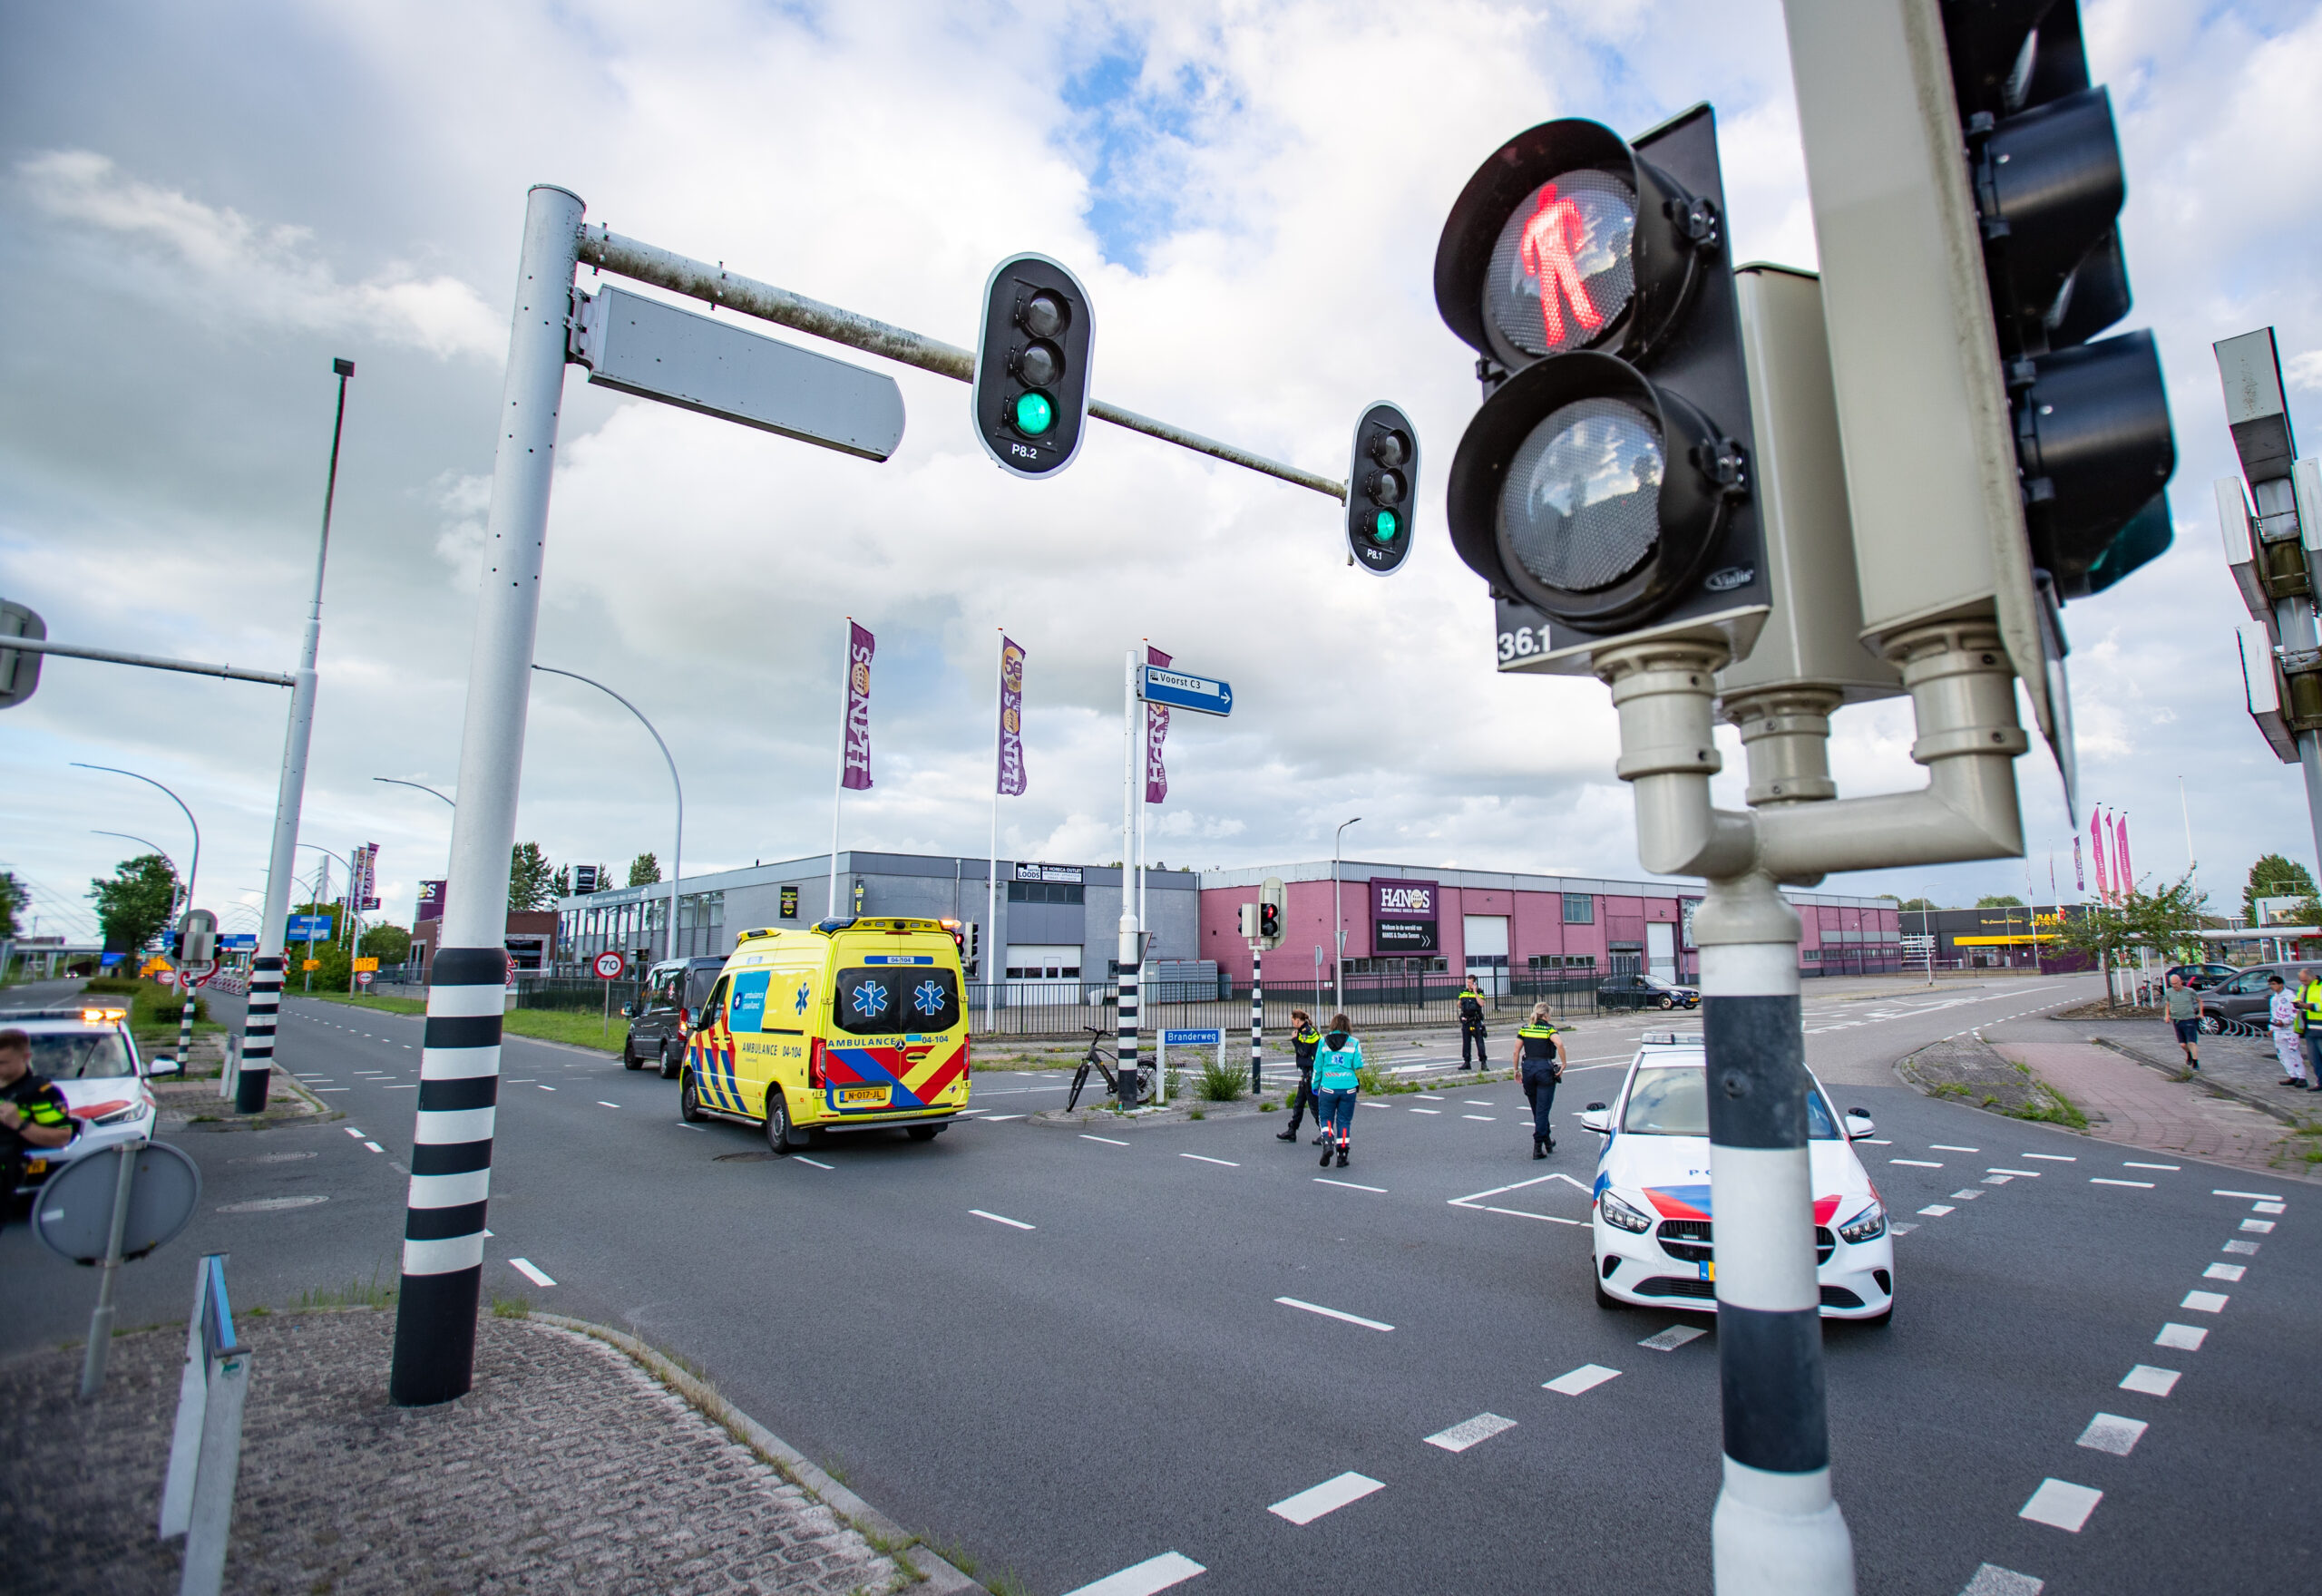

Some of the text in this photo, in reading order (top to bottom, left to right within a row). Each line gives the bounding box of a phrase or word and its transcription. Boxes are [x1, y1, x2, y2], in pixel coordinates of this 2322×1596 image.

[1011, 443, 1038, 460] P8.2
[1367, 548, 1382, 560] P8.1
[1498, 624, 1551, 661] 36.1
[1160, 673, 1202, 689] Voorst C3
[845, 643, 871, 773] HANOS
[1001, 692, 1020, 793] HANOS
[1381, 888, 1430, 909] HANOS
[600, 960, 618, 970] 70
[828, 1037, 895, 1047] AMBULANCE
[922, 1036, 949, 1044] 04-104
[1167, 1032, 1216, 1043] Branderweg
[742, 1042, 802, 1057] AMBULANCE 04-104
[848, 1090, 881, 1100] N-017-JL
